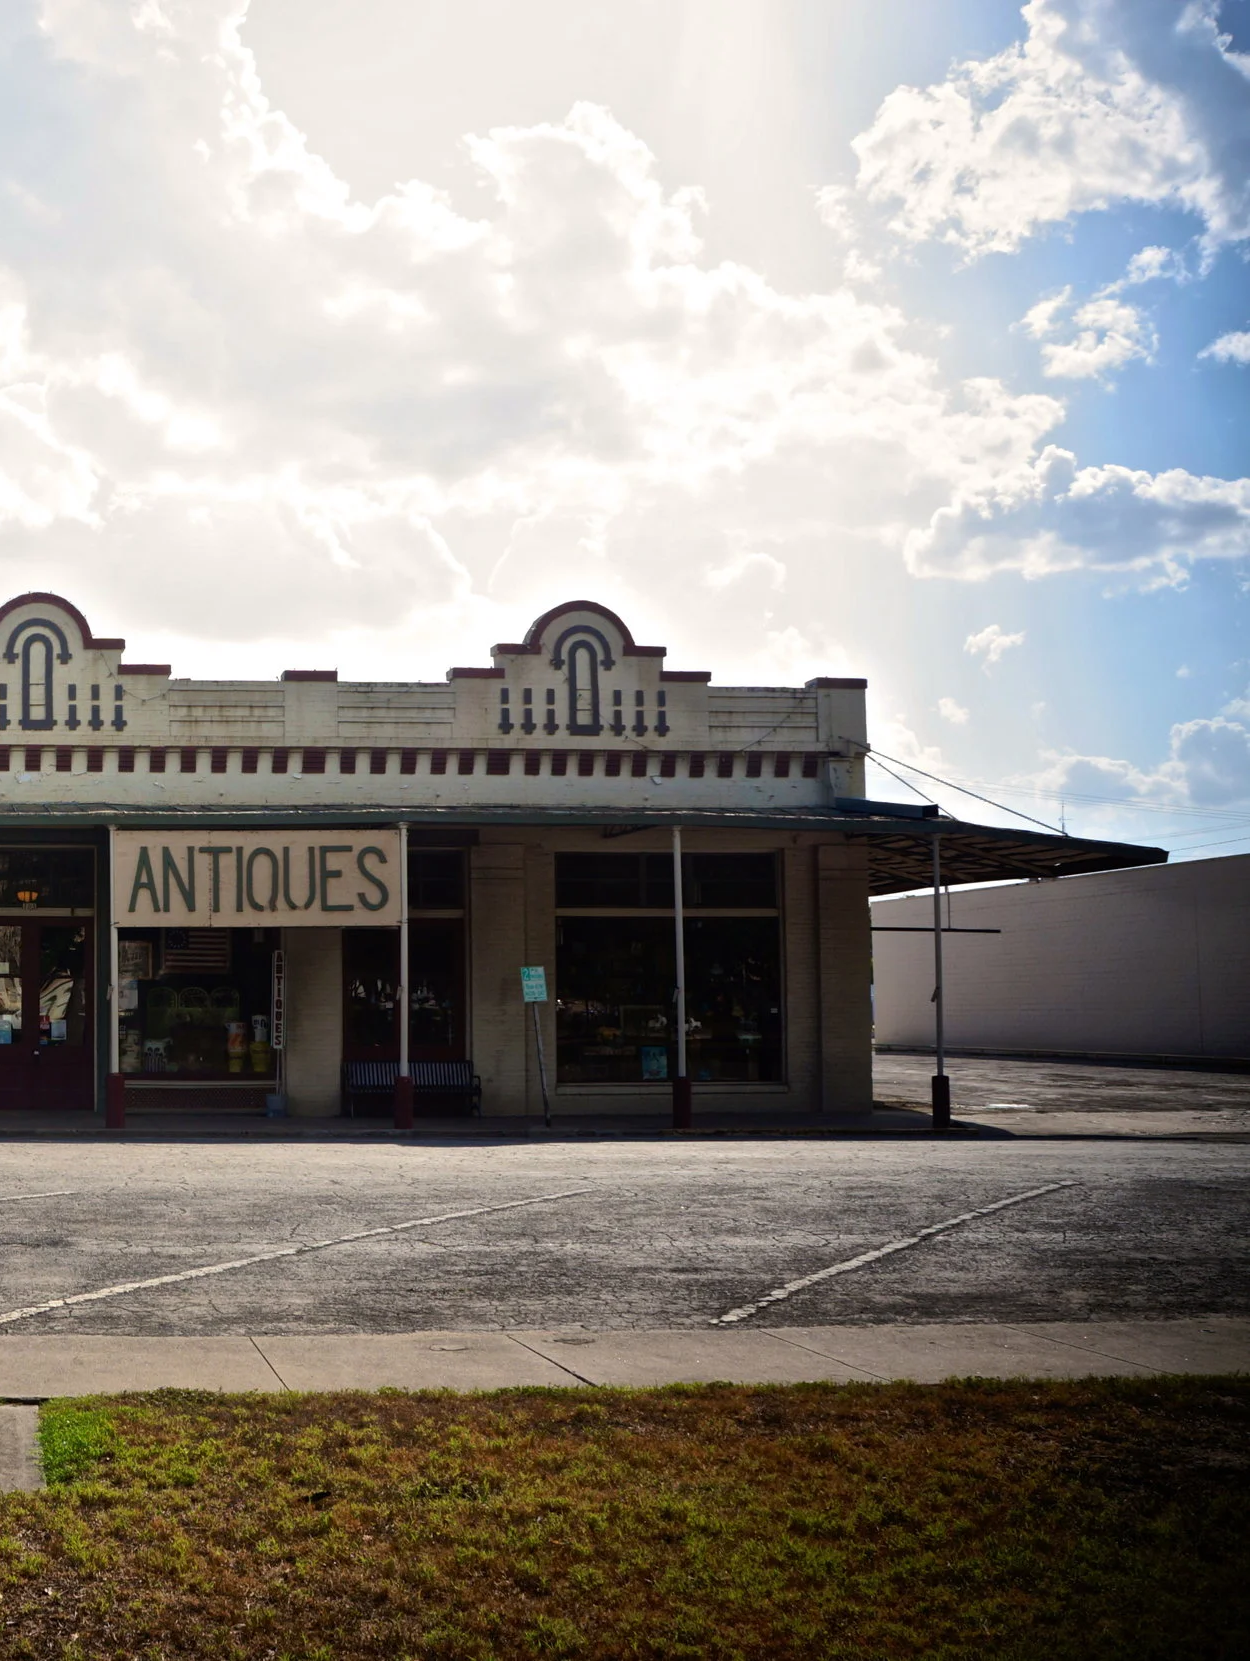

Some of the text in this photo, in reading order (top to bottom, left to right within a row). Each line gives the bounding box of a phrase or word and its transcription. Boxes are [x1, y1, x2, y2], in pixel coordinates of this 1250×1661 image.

[128, 846, 390, 912] ANTIQUES
[274, 952, 283, 1046] ANTIQUES
[522, 968, 530, 980] 2
